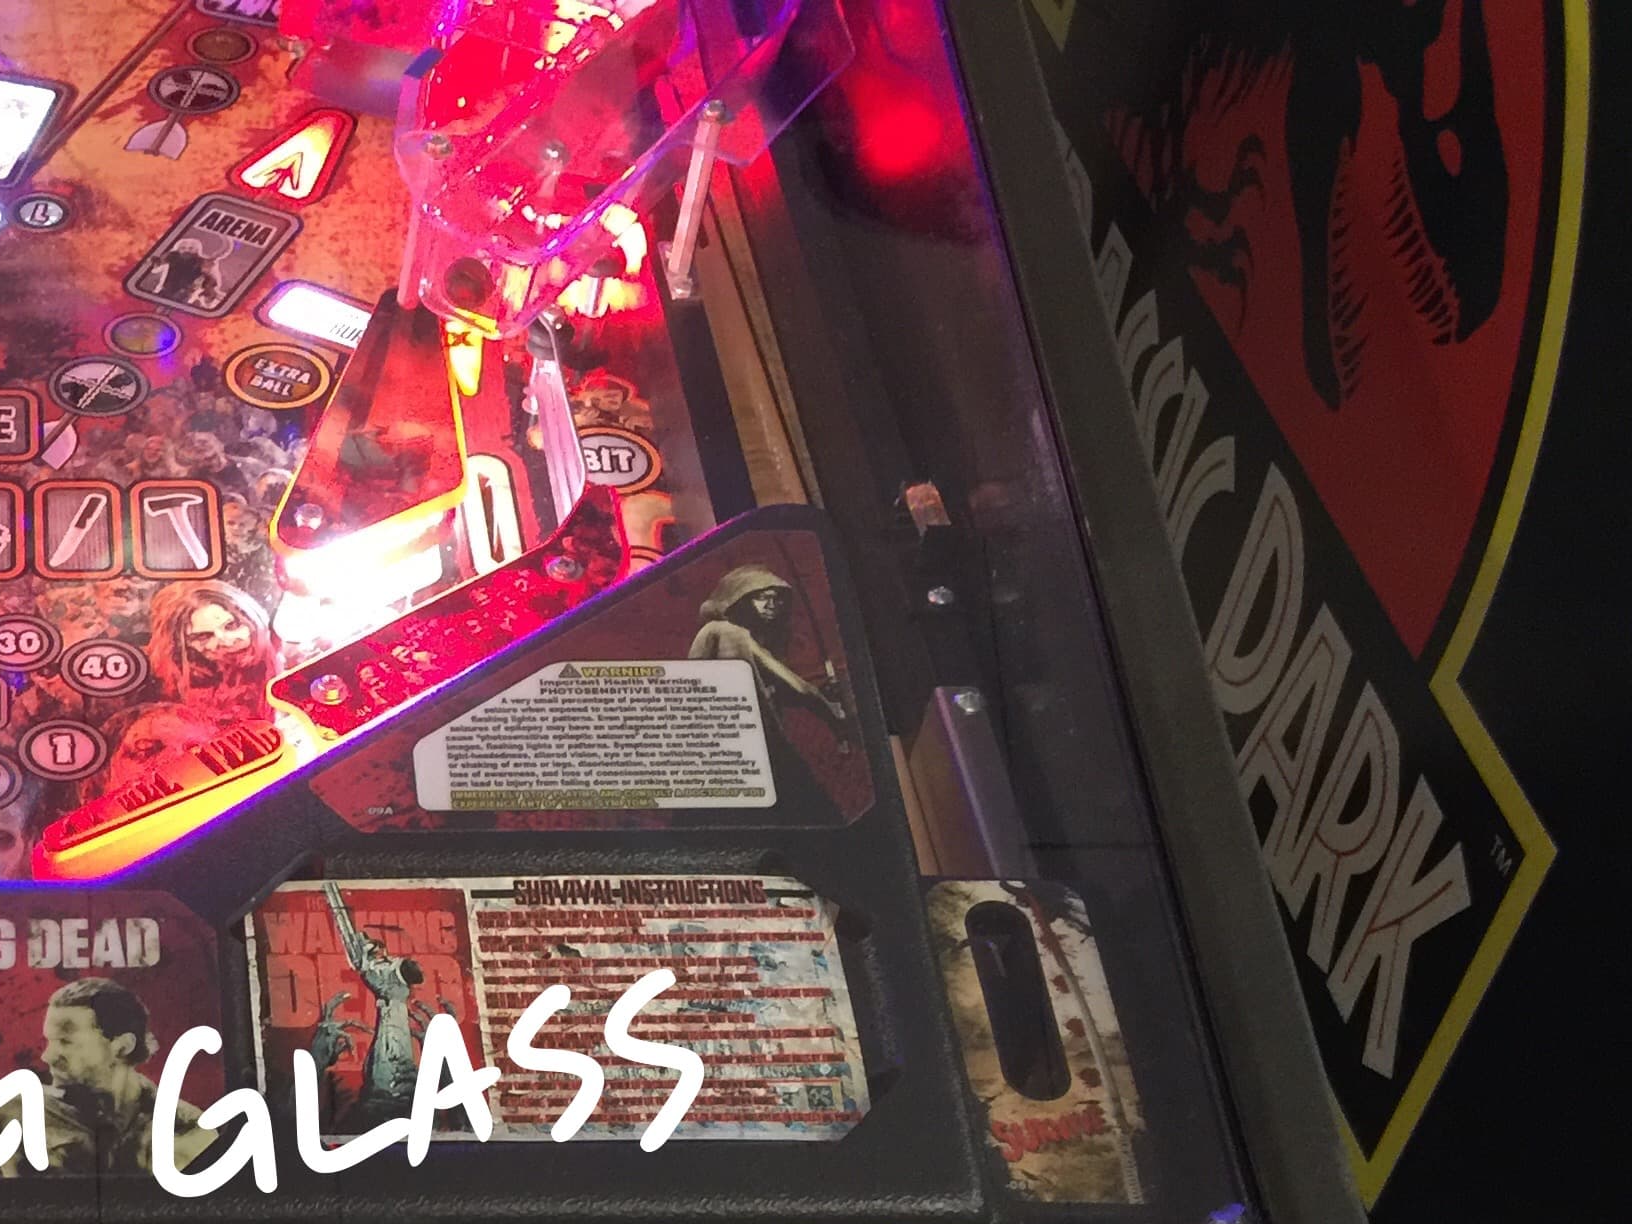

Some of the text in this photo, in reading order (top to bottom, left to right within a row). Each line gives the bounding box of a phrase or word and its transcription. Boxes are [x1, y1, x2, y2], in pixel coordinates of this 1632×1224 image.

[199, 210, 273, 246] ARENA
[254, 358, 310, 384] EXTRA
[250, 375, 293, 396] BALL
[80, 654, 129, 680] 40
[581, 666, 666, 678] WARNING
[539, 678, 600, 688] Important
[647, 677, 702, 687] Warning:
[539, 686, 718, 695] PHOTOSENSITIVE SEIZURES
[49, 733, 76, 763] 1
[513, 878, 769, 905] SURVIVAL INSTRUCTIONS
[27, 918, 161, 969] DEAD
